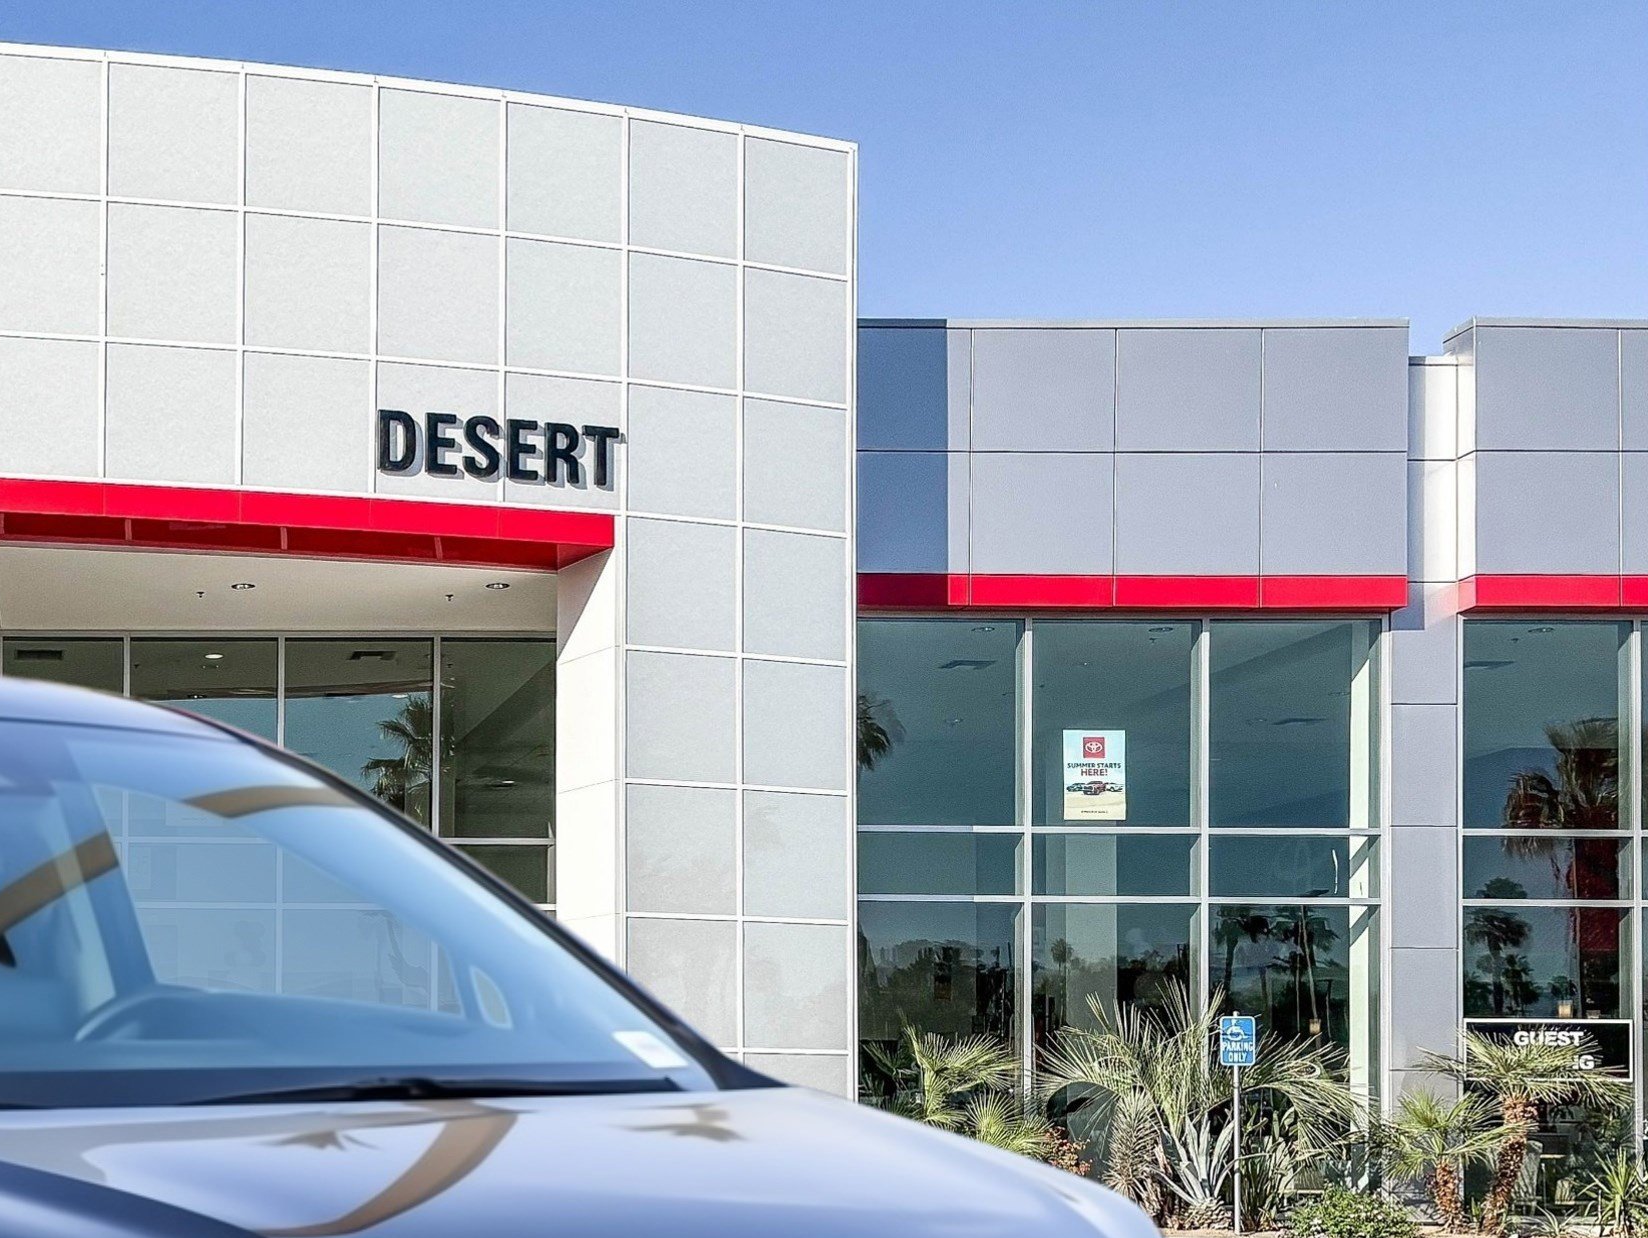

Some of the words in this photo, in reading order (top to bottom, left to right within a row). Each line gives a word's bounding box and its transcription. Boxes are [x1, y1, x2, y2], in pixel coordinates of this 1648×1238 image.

[377, 409, 620, 487] DESERT
[1080, 768, 1108, 776] HERE!
[1513, 1030, 1585, 1046] GUEST
[1222, 1041, 1253, 1052] PARKING
[1228, 1052, 1248, 1062] ONLY
